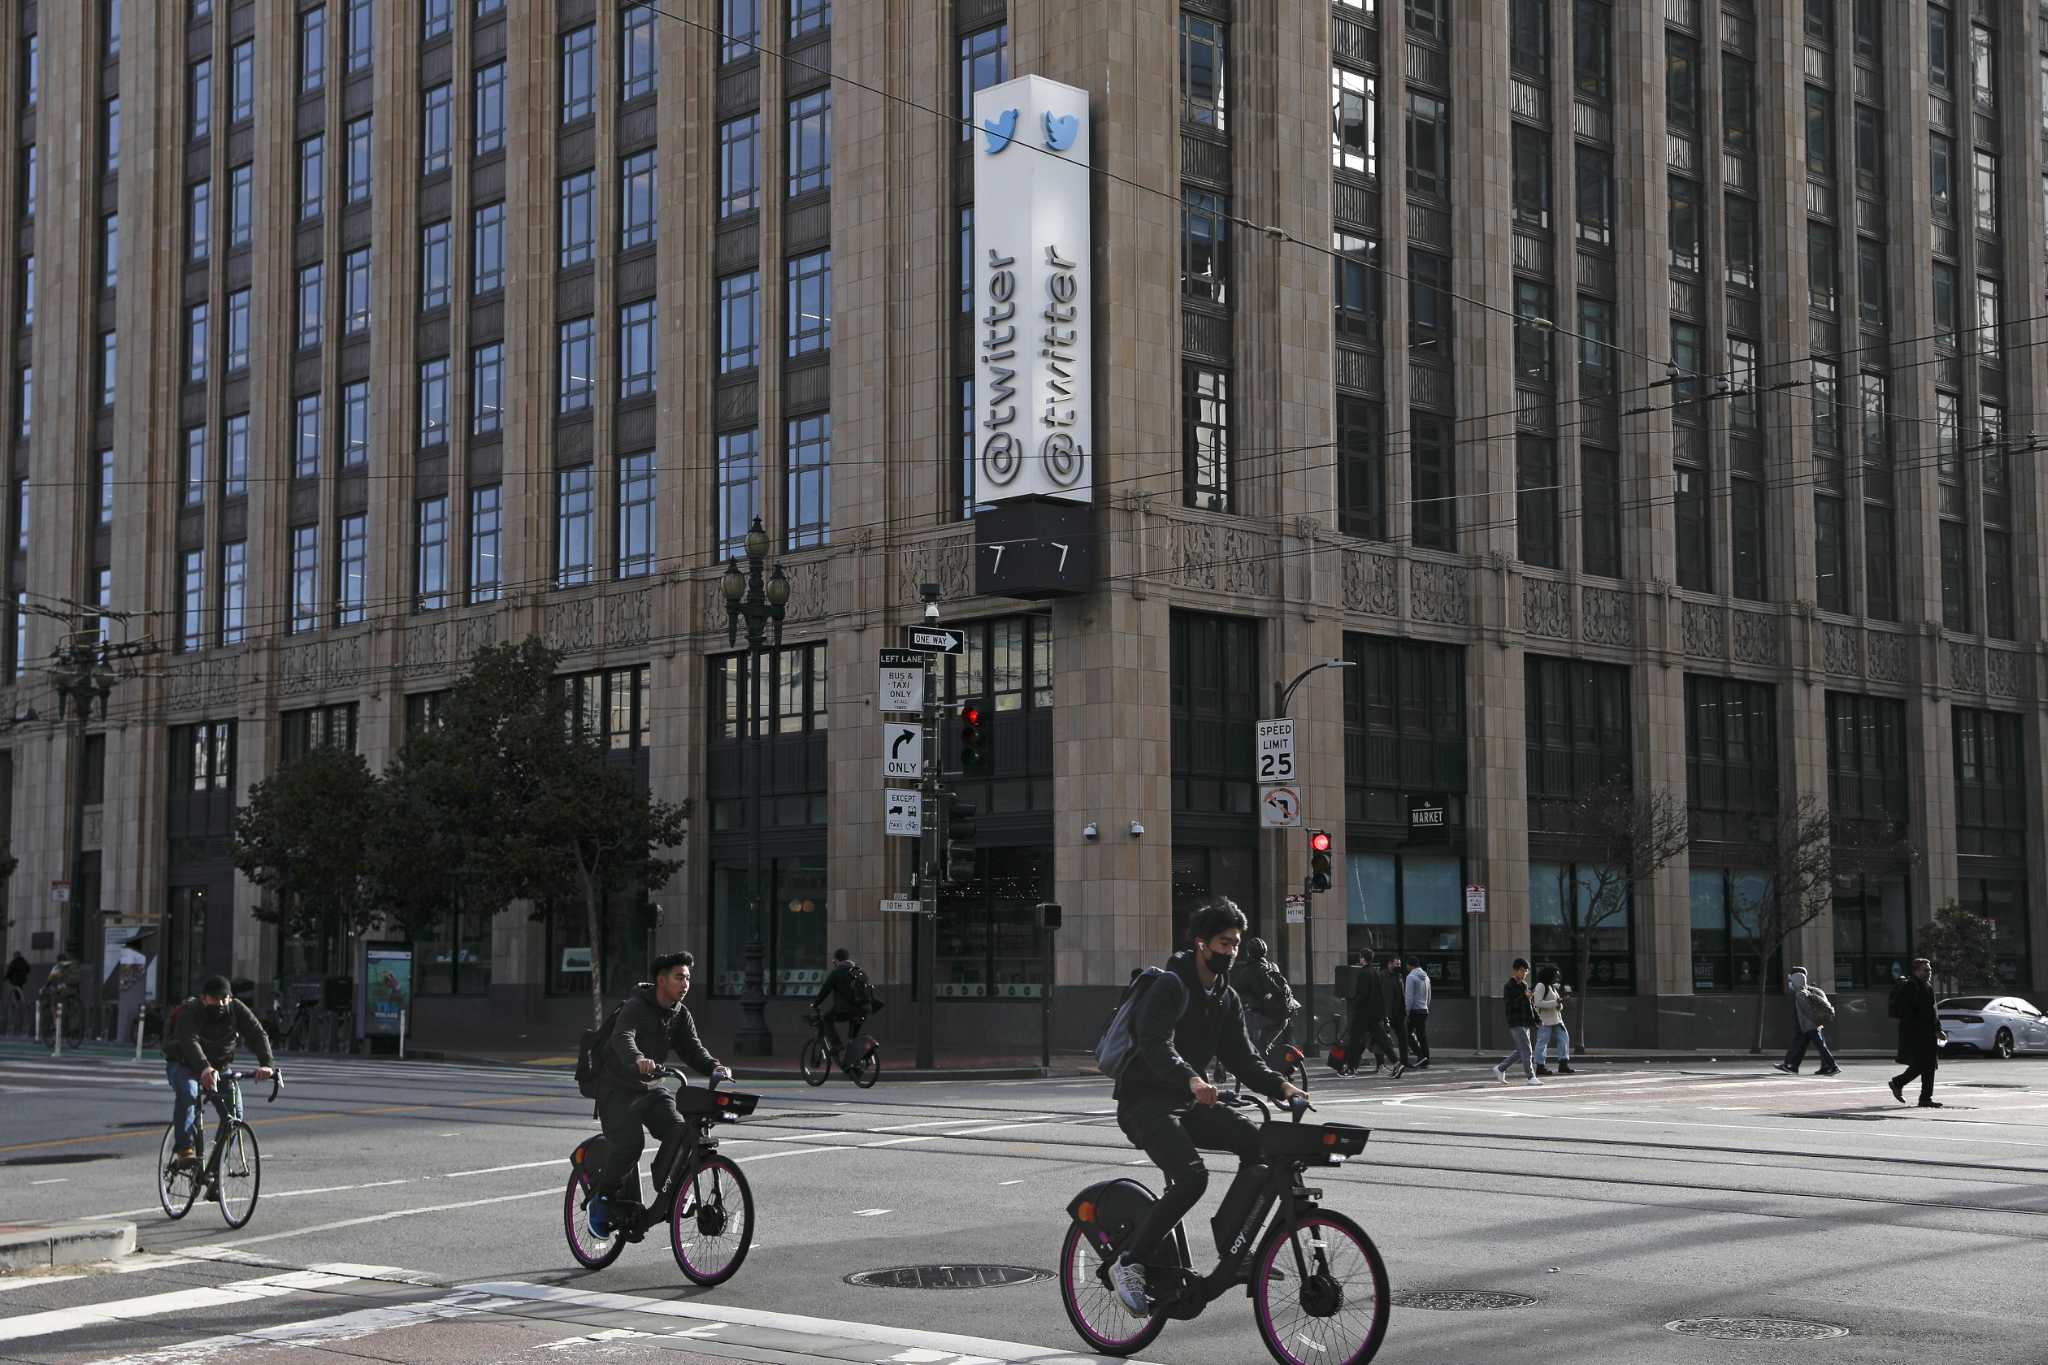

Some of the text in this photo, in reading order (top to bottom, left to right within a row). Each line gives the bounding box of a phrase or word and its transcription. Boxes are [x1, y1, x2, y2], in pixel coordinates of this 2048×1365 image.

[982, 248, 1023, 487] @twitter
[1042, 244, 1085, 487] @twitter
[915, 635, 947, 646] ONE WAY
[880, 655, 923, 663] LEFT LANE
[888, 671, 913, 680] BUS &
[892, 681, 910, 689] TAXI
[889, 689, 911, 698] ONLY
[1260, 725, 1291, 736] SPEED
[1263, 738, 1289, 750] LIMIT
[888, 761, 917, 773] ONLY
[1261, 752, 1292, 777] 25
[891, 794, 917, 804] EXCEPT
[1411, 811, 1443, 825] MARKET
[906, 901, 914, 911] ST
